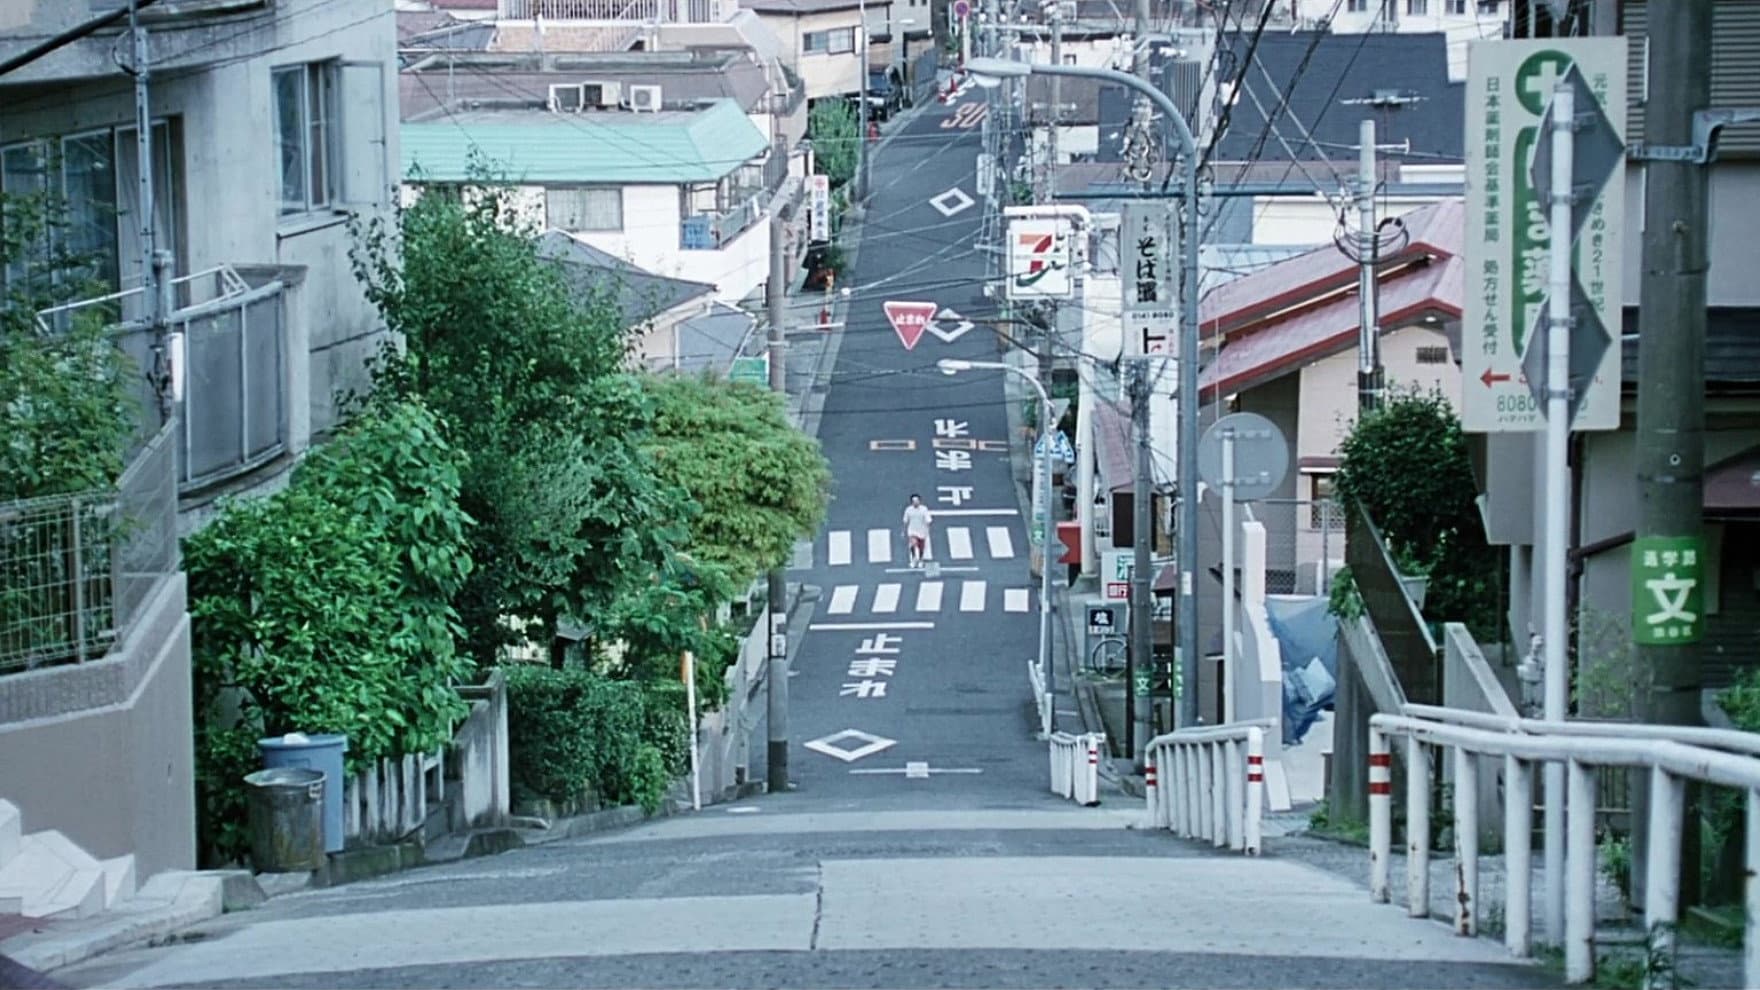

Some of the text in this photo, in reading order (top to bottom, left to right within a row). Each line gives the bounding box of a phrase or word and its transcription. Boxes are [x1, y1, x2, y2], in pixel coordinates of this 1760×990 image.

[1482, 76, 1501, 355] 日本薬剤師会基準薬局 処方せん受付
[895, 313, 926, 326] 止まれ
[1643, 550, 1697, 567] 通学路
[1645, 572, 1697, 625] 文
[838, 633, 902, 698] 止まれ
